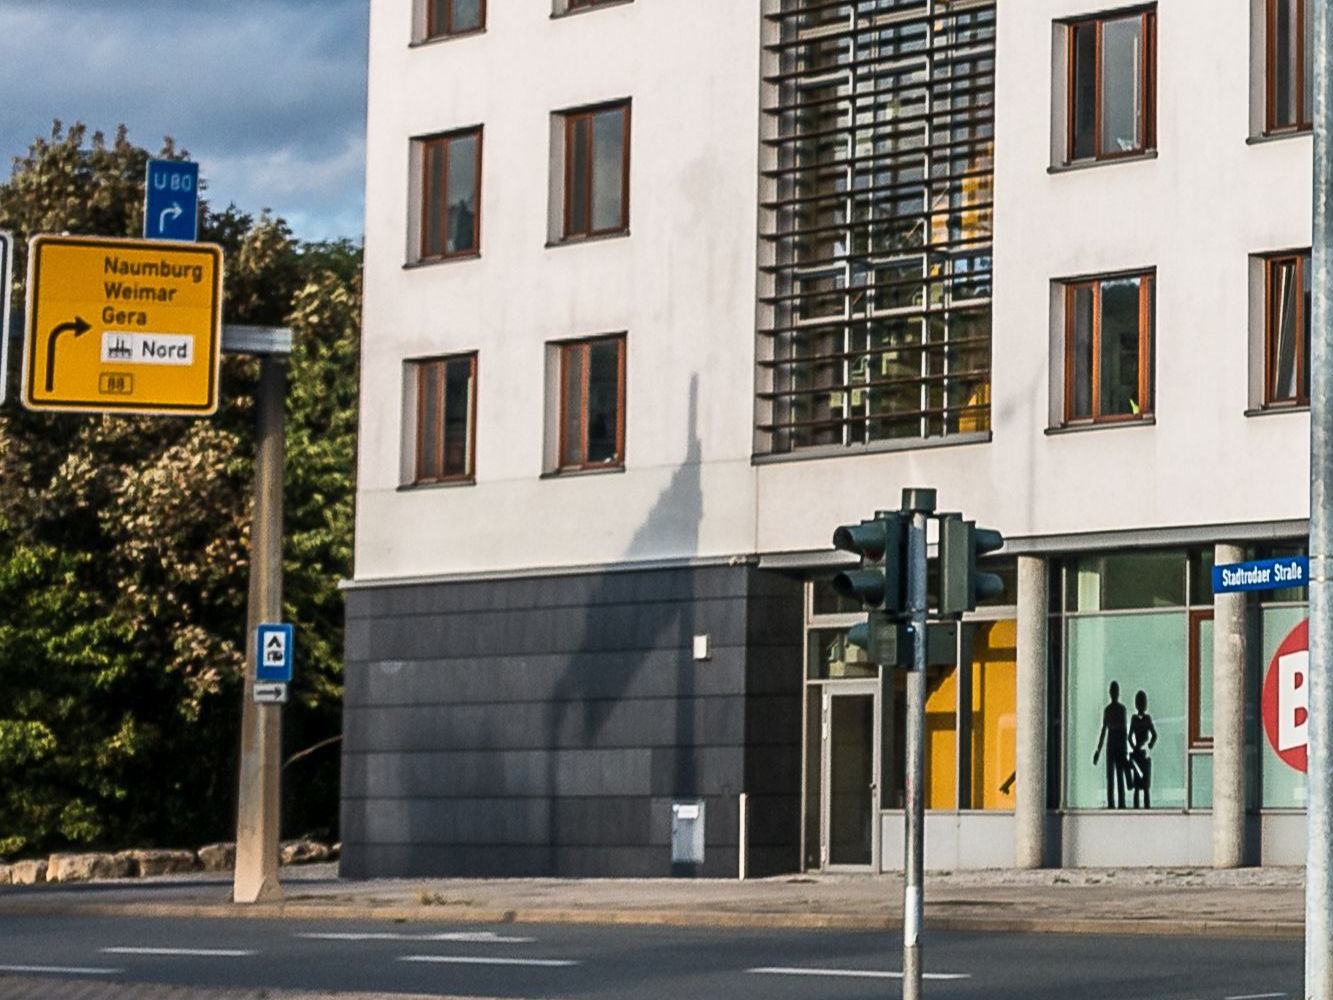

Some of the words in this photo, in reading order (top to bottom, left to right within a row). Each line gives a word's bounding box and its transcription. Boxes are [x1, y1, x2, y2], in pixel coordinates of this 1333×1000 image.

[154, 172, 166, 190] U
[104, 256, 202, 283] Naumburg
[104, 281, 177, 302] Weimar
[102, 305, 147, 326] Gera
[142, 340, 187, 359] Nord
[1222, 566, 1271, 587] Stadtrodaer
[1274, 562, 1302, 582] Straße
